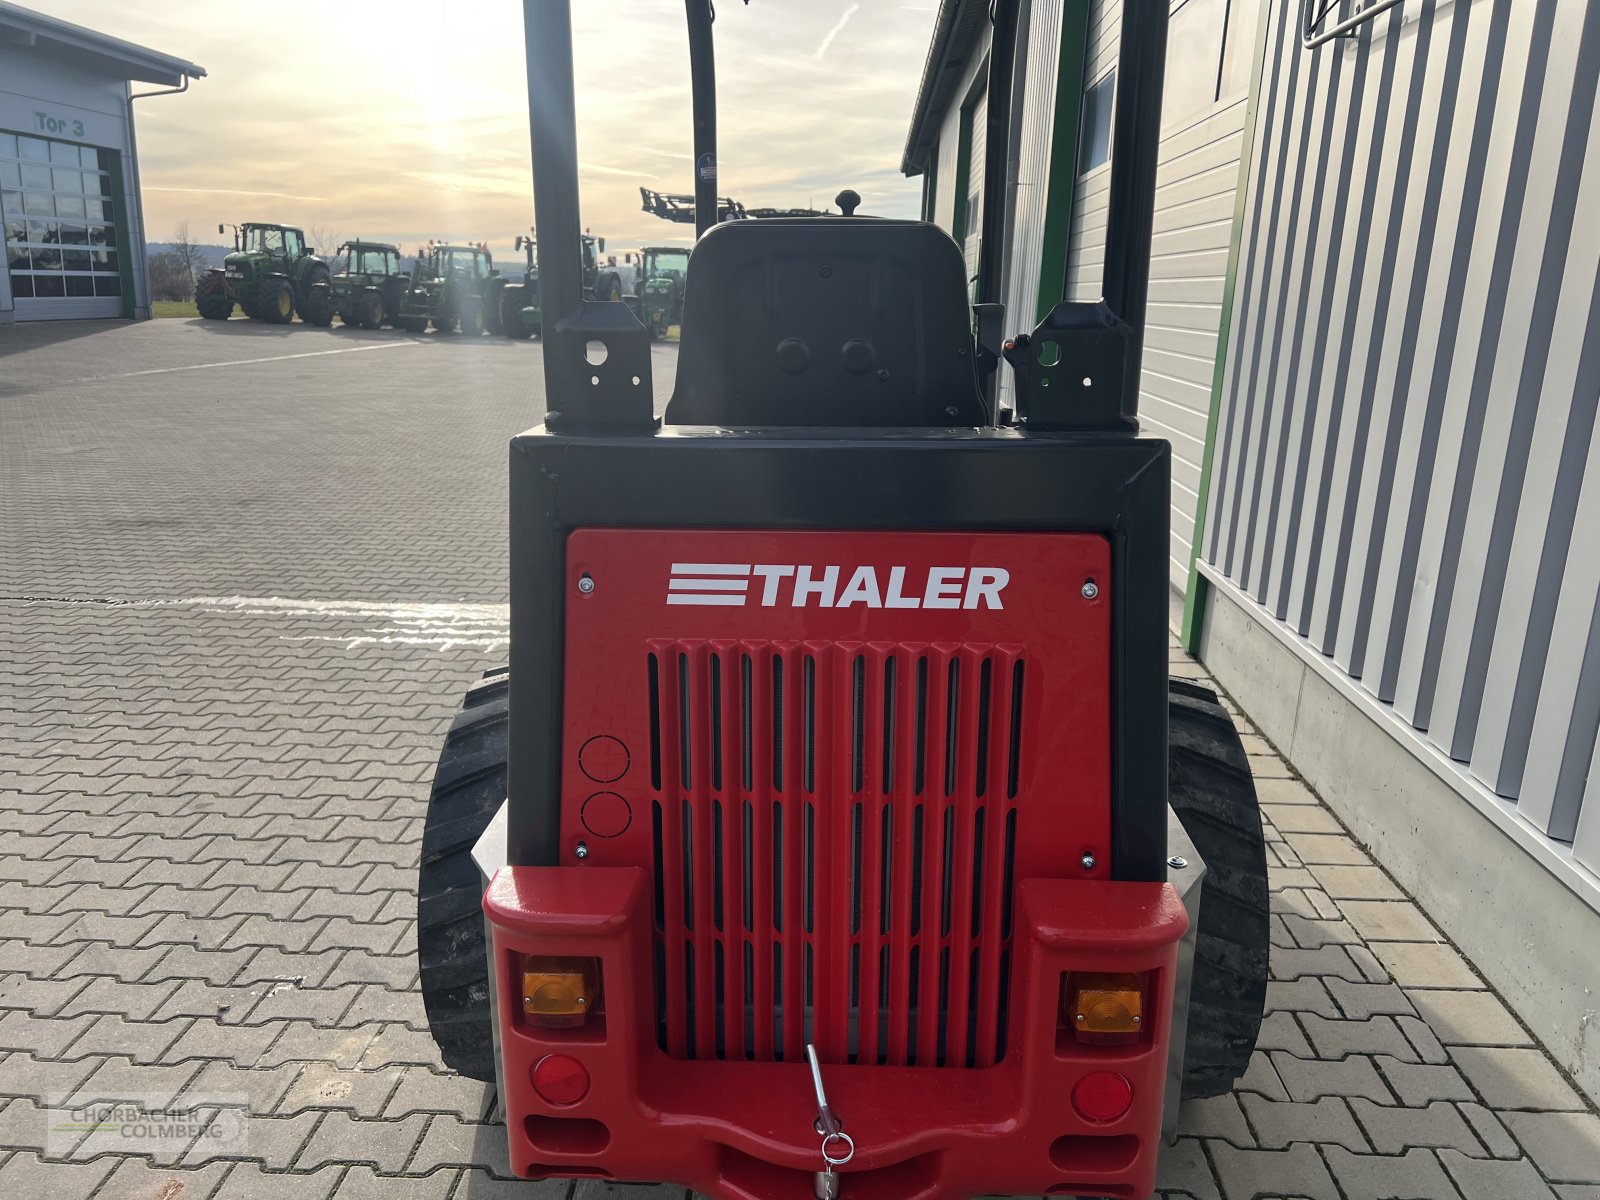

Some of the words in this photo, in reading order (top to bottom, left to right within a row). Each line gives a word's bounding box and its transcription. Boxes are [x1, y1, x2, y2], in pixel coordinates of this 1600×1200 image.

[35, 111, 66, 134] Tor
[71, 119, 85, 138] 3
[752, 564, 1010, 610] THALER
